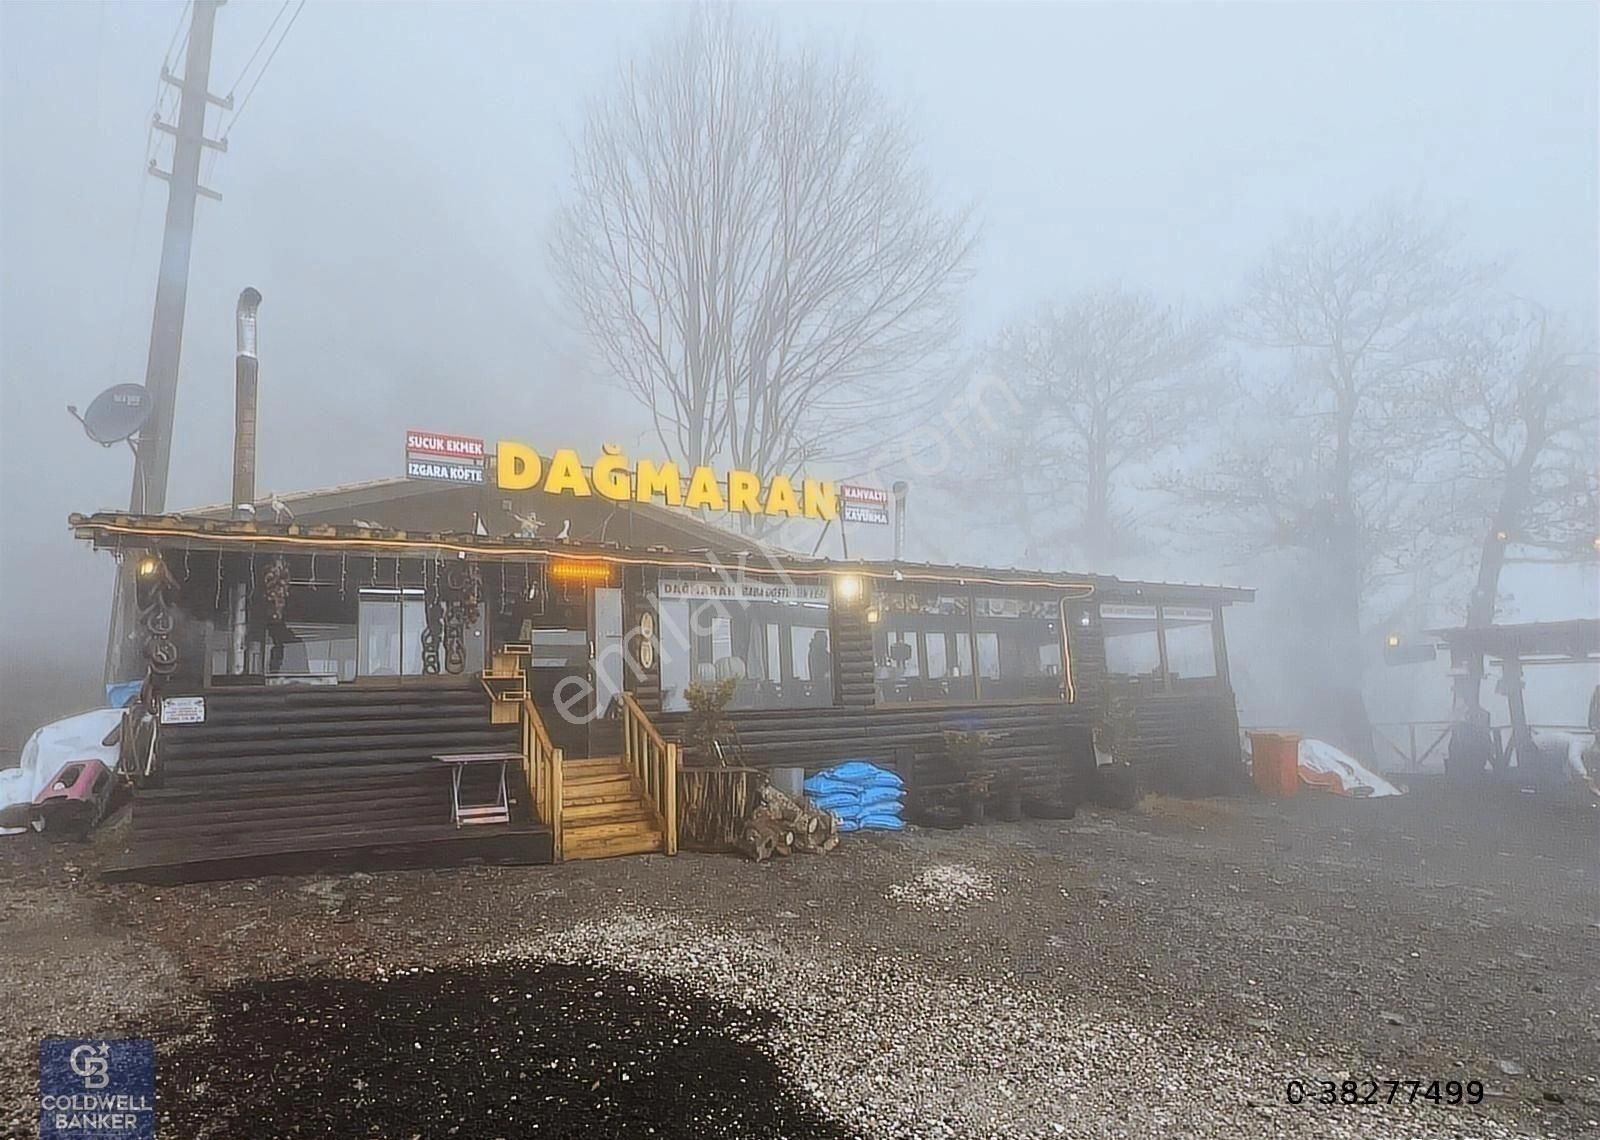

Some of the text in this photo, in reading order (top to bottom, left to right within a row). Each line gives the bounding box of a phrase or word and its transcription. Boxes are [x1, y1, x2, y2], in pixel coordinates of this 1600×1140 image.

[408, 435, 482, 455] SUCUK EKMEK
[408, 462, 483, 481] IZGARA KÖFTE
[496, 440, 839, 521] DAĞMARAN
[845, 507, 888, 523] KAVURMA
